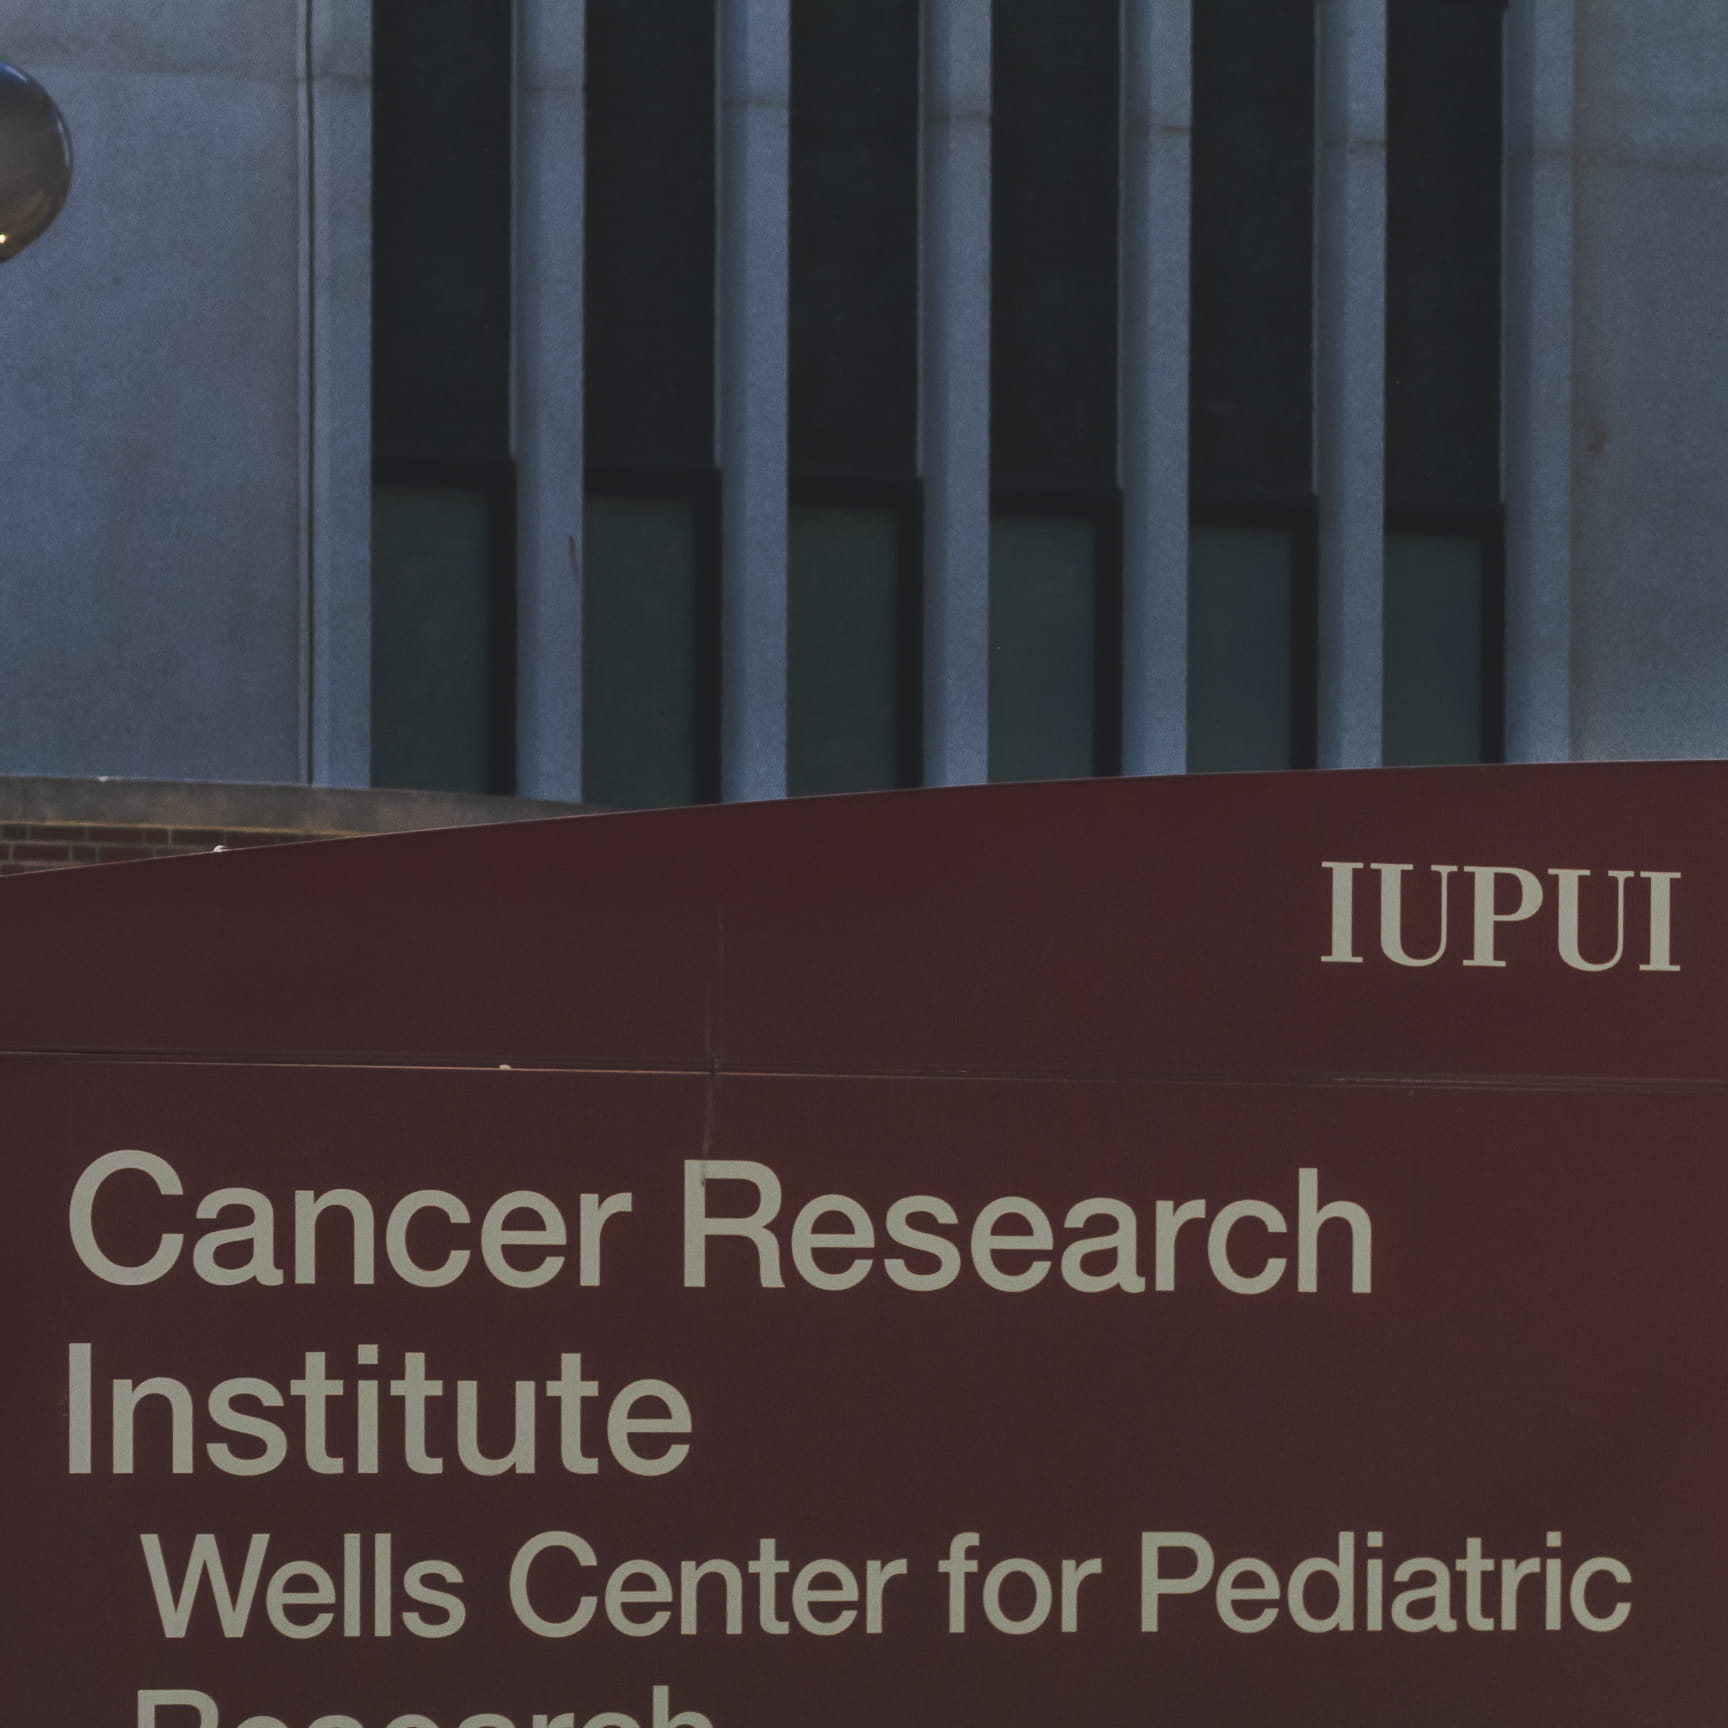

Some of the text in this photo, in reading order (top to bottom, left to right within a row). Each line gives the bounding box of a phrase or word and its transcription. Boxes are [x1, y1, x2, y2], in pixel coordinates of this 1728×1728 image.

[1321, 861, 1682, 973] IUPUI
[68, 1149, 1372, 1295] Cancer Research
[68, 1342, 693, 1477] Institute
[140, 1530, 1633, 1640] Wells Center for Pediatric
